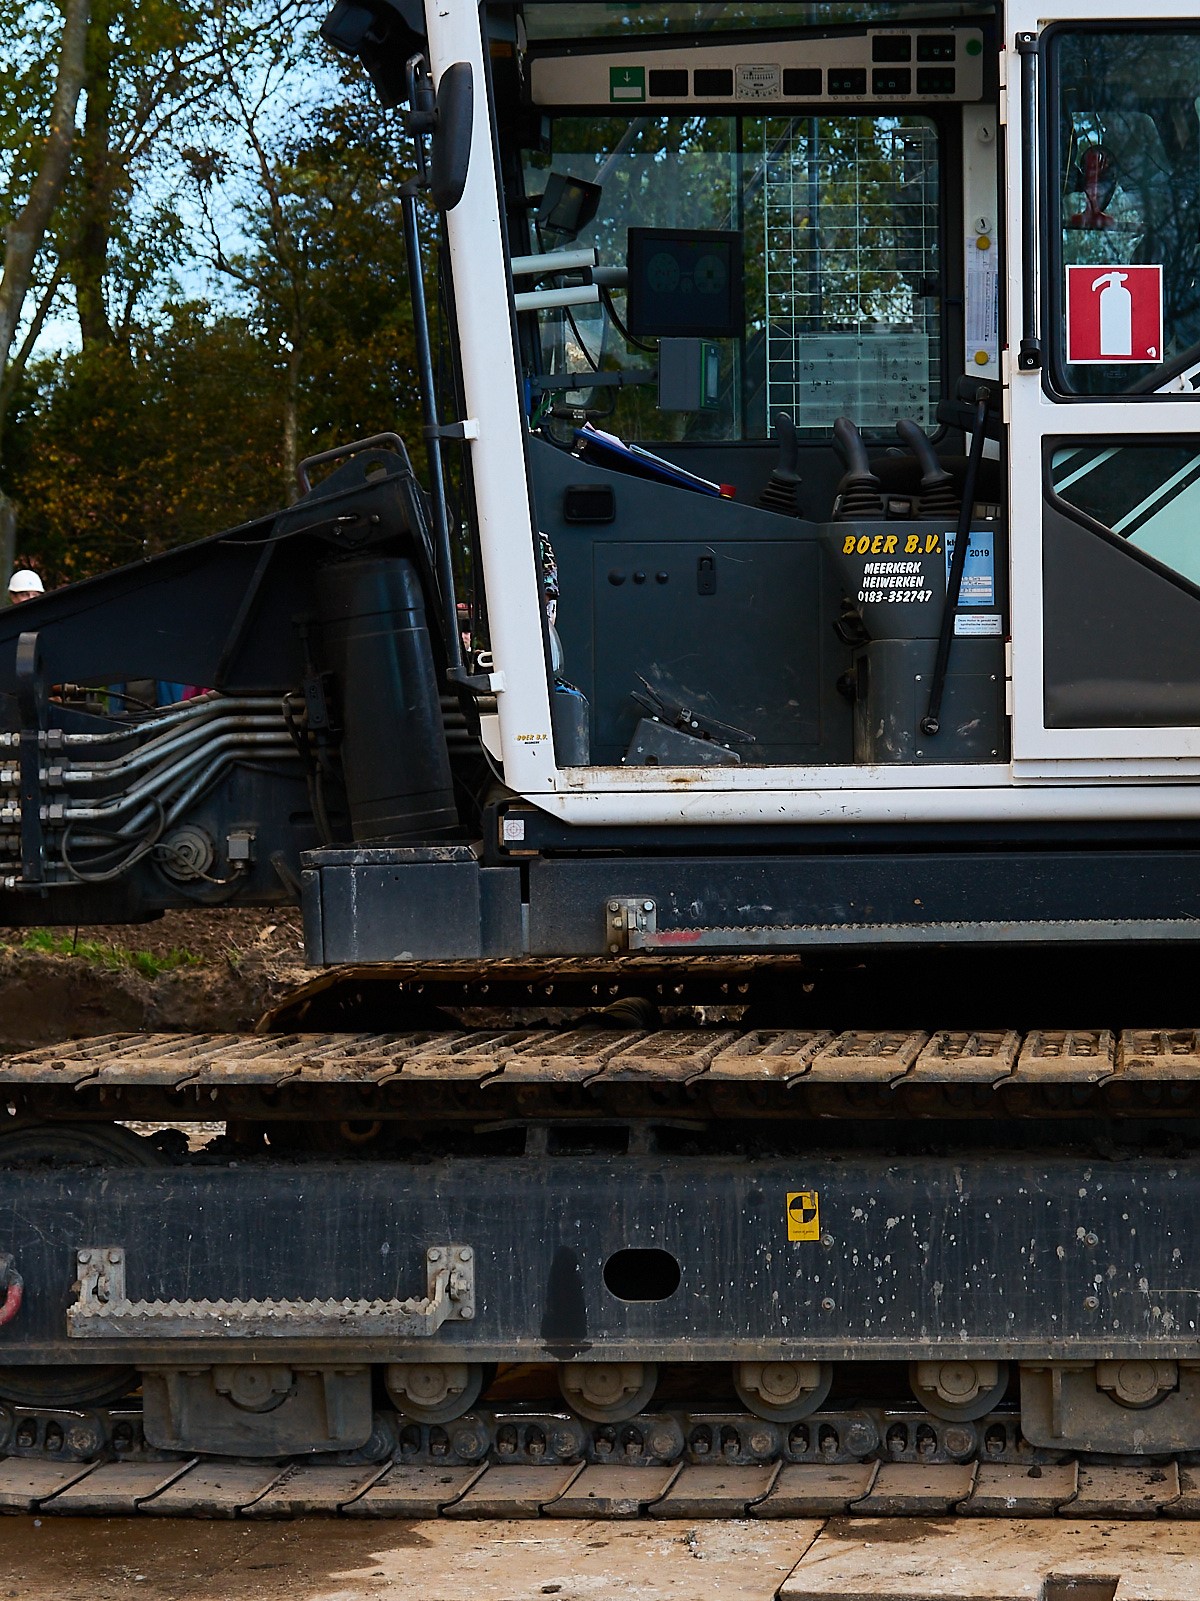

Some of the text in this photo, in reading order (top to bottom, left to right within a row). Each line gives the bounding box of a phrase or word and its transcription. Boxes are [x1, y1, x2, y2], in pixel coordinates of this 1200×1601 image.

[842, 534, 942, 554] BOER B.V.
[969, 549, 990, 558] 2019
[864, 562, 921, 575] MEERKERK
[862, 575, 925, 588] HEIWERKEN
[857, 590, 933, 603] 0183-352747
